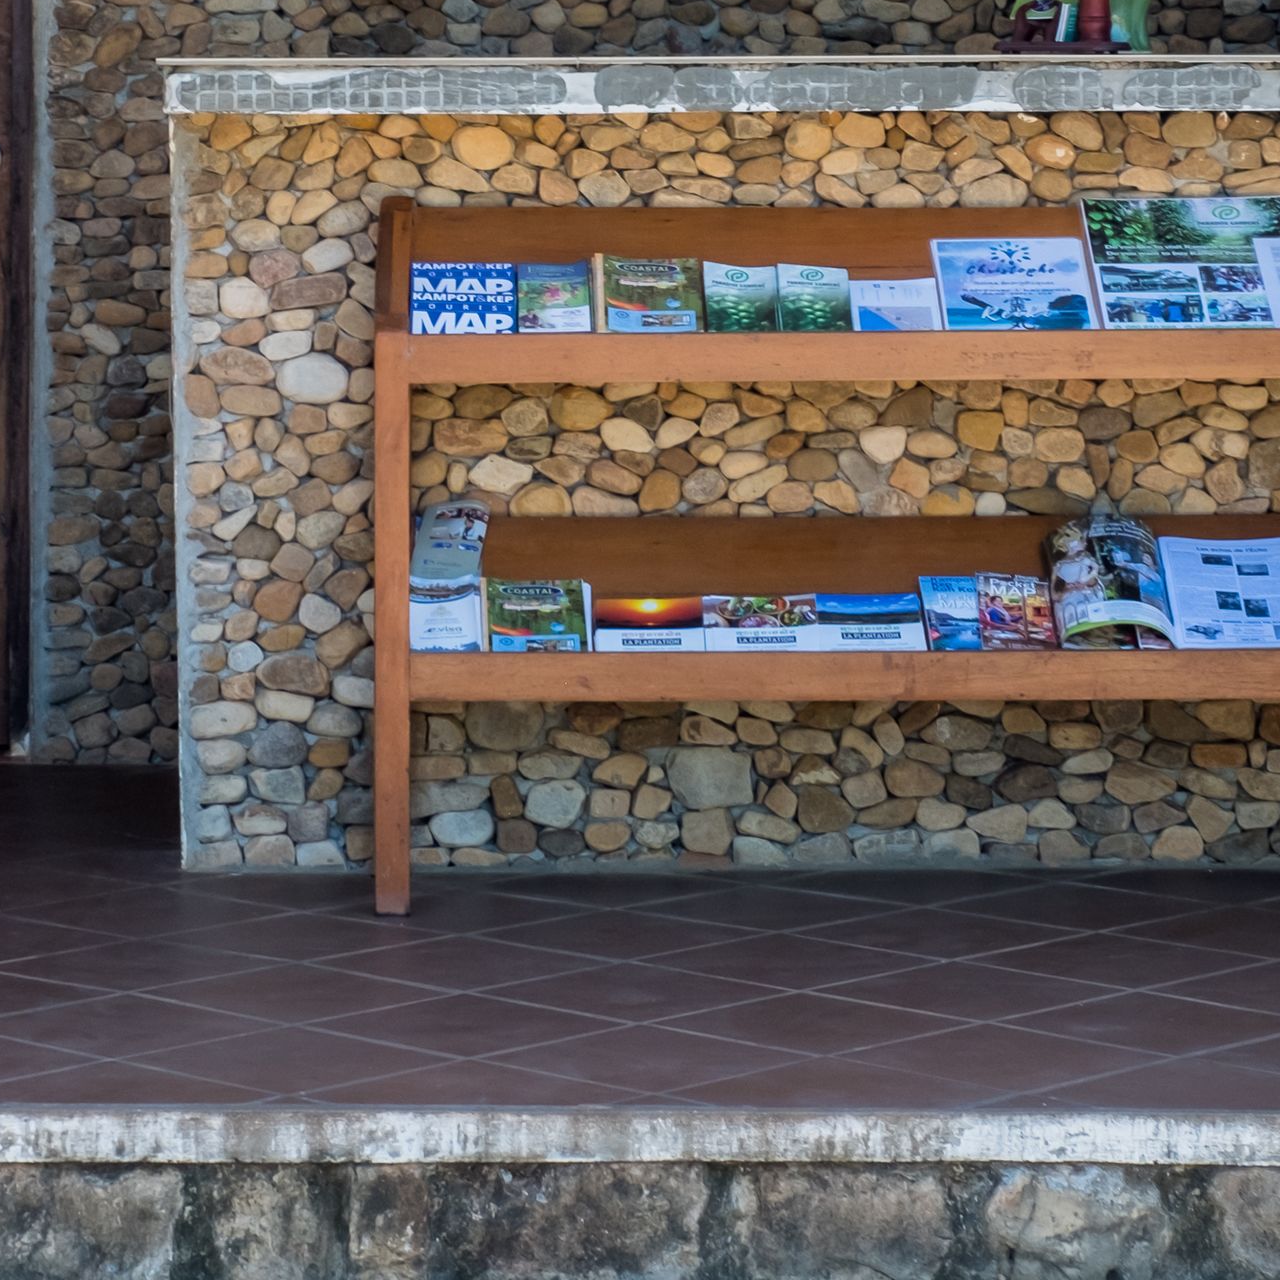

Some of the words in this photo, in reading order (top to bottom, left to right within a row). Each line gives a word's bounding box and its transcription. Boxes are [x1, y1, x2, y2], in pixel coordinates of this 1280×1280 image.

[413, 277, 514, 294] MAP
[413, 302, 513, 311] TOURIST
[412, 311, 514, 334] MAP
[989, 585, 1037, 598] MAP
